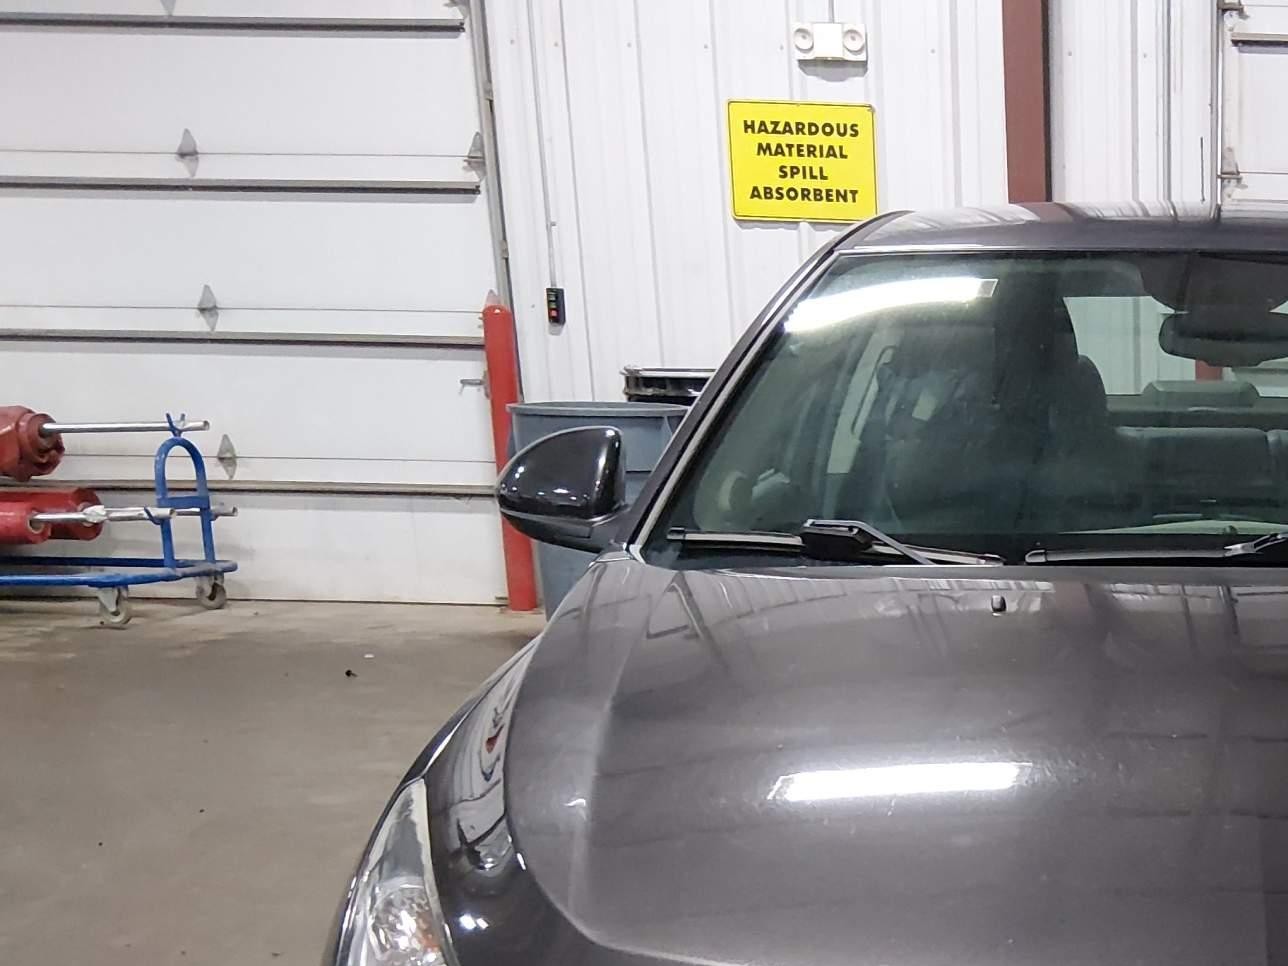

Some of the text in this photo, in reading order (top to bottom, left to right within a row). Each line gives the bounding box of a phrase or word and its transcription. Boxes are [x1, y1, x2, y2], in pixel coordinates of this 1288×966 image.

[743, 119, 859, 138] HAZARDOUS
[756, 142, 848, 160] MATERIAL
[778, 164, 829, 181] SPILL
[749, 185, 859, 203] ABSORBENT
